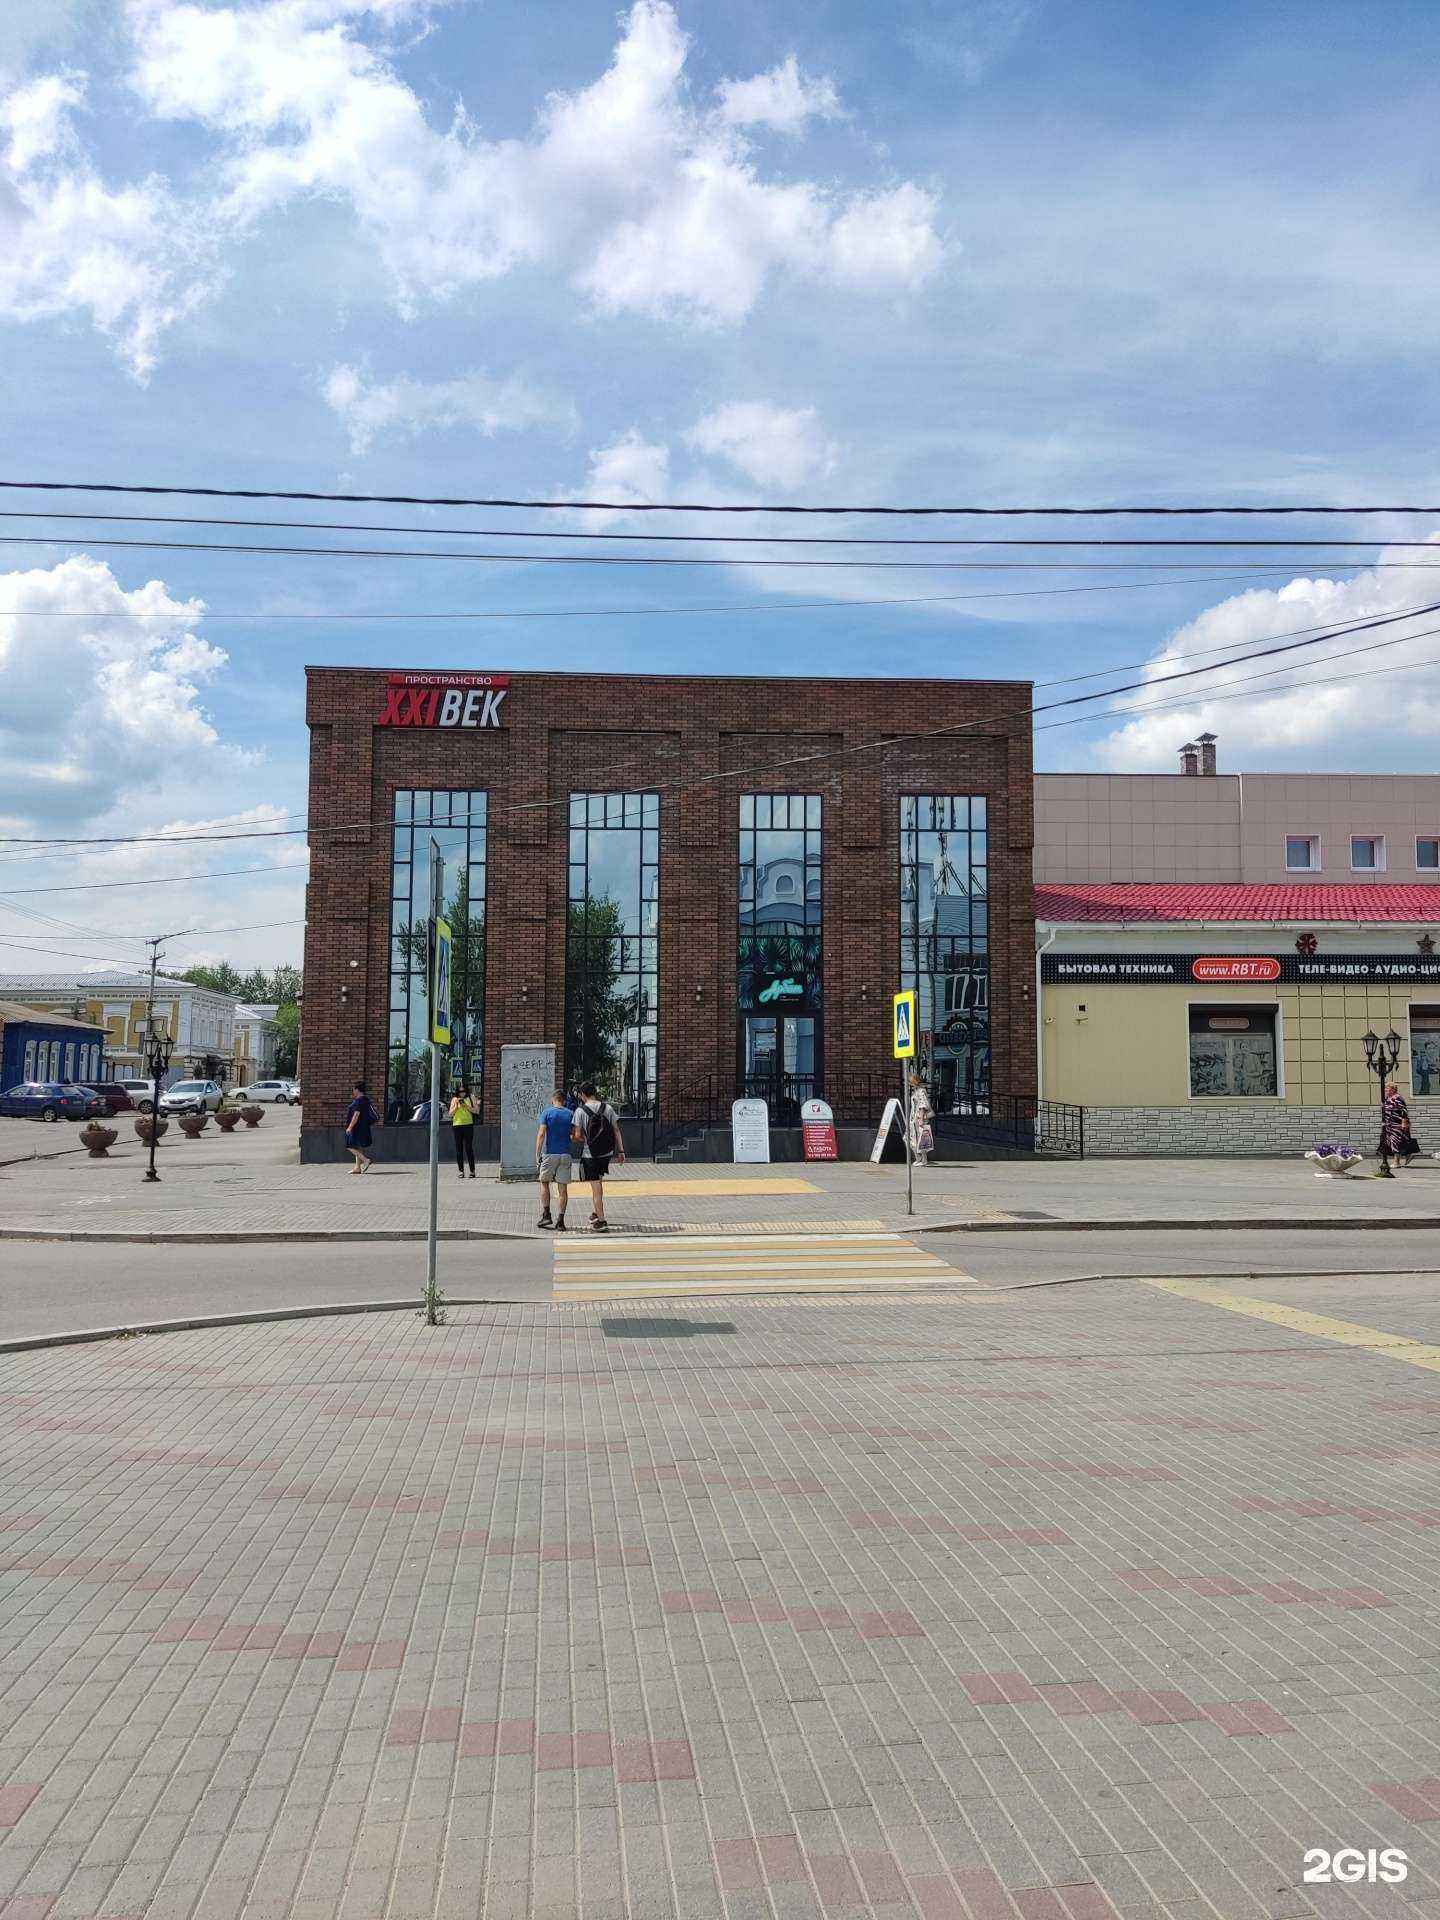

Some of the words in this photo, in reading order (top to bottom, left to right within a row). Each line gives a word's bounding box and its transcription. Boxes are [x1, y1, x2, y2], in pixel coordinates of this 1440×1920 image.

[405, 676, 492, 685] ПРОСТРАНСТВО
[1058, 964, 1116, 974] БЫТОВАЯ
[1120, 964, 1174, 974] ТЕХНИКА
[1199, 963, 1271, 975] www.RBT.ru
[1299, 964, 1440, 975] ТЕЛЕ-ВИДЕО-АУДИО-ЦИ
